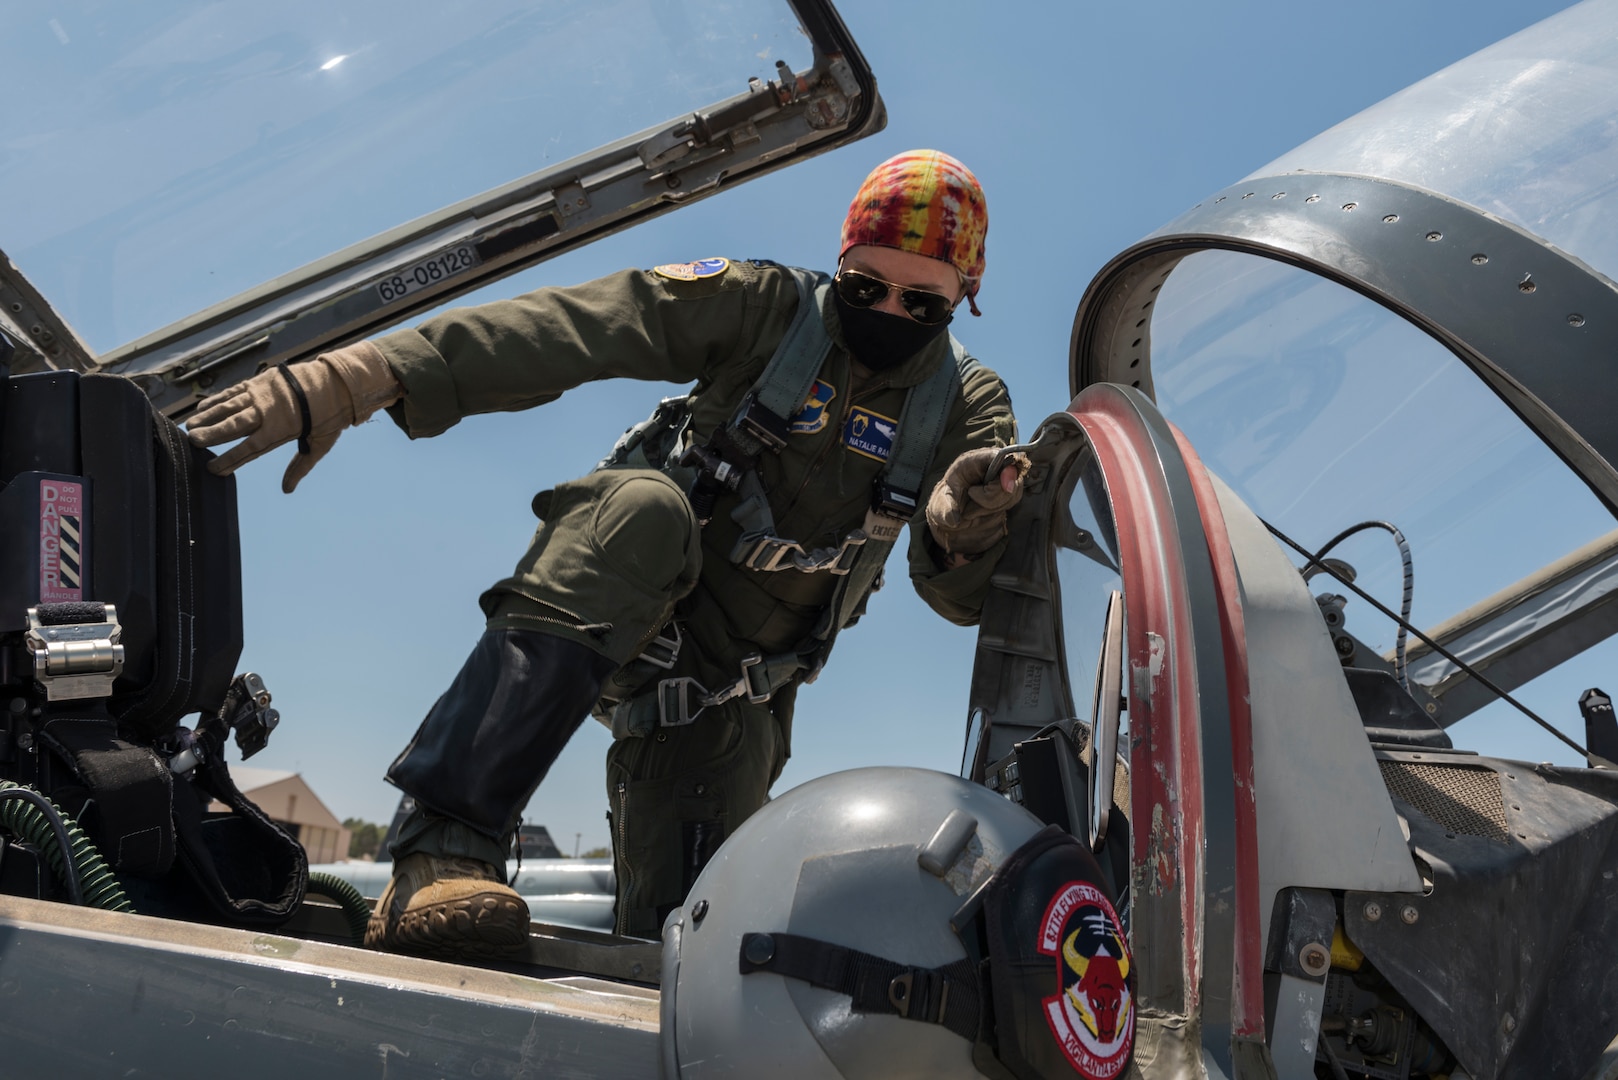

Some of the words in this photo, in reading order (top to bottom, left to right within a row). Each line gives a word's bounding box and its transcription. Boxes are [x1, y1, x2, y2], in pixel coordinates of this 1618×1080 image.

[379, 248, 473, 301] 68-08128
[848, 436, 878, 453] NATALIE
[62, 486, 75, 494] DO
[59, 496, 78, 504] NOT
[58, 505, 79, 514] PULL
[41, 486, 59, 588] DANGER
[43, 591, 79, 601] HANDLE
[1046, 908, 1064, 943] 87TH
[1059, 888, 1085, 915] FLYING
